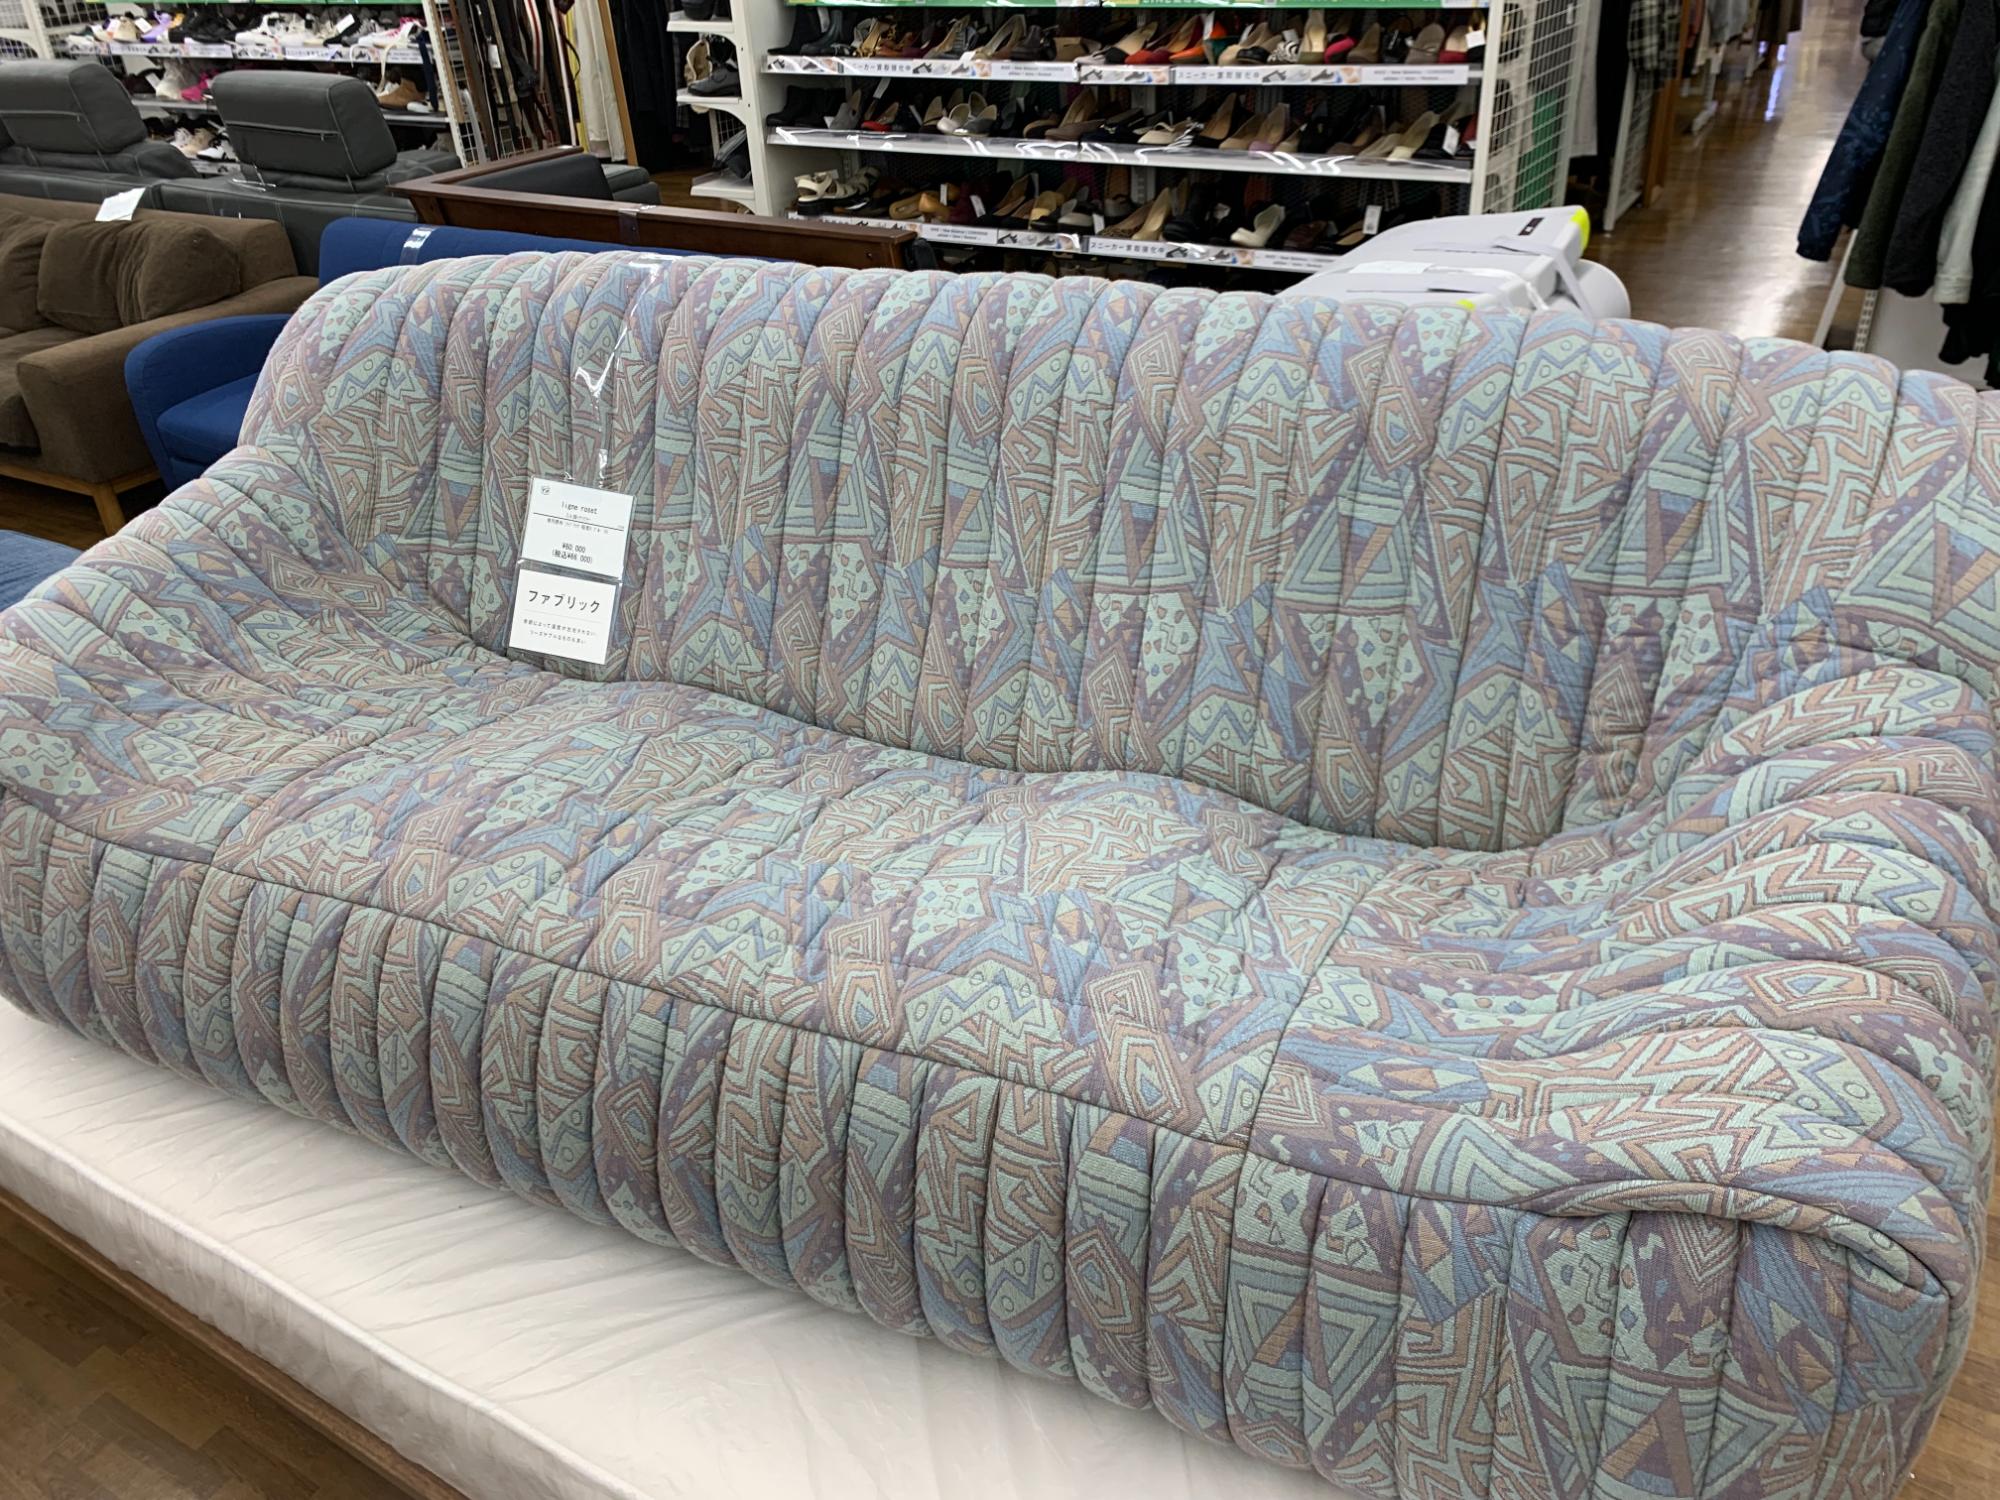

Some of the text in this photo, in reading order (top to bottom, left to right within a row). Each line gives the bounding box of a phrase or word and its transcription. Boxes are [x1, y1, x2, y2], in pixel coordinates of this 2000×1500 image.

[562, 543, 586, 554] ¥60000
[528, 590, 601, 613] ファブリック
